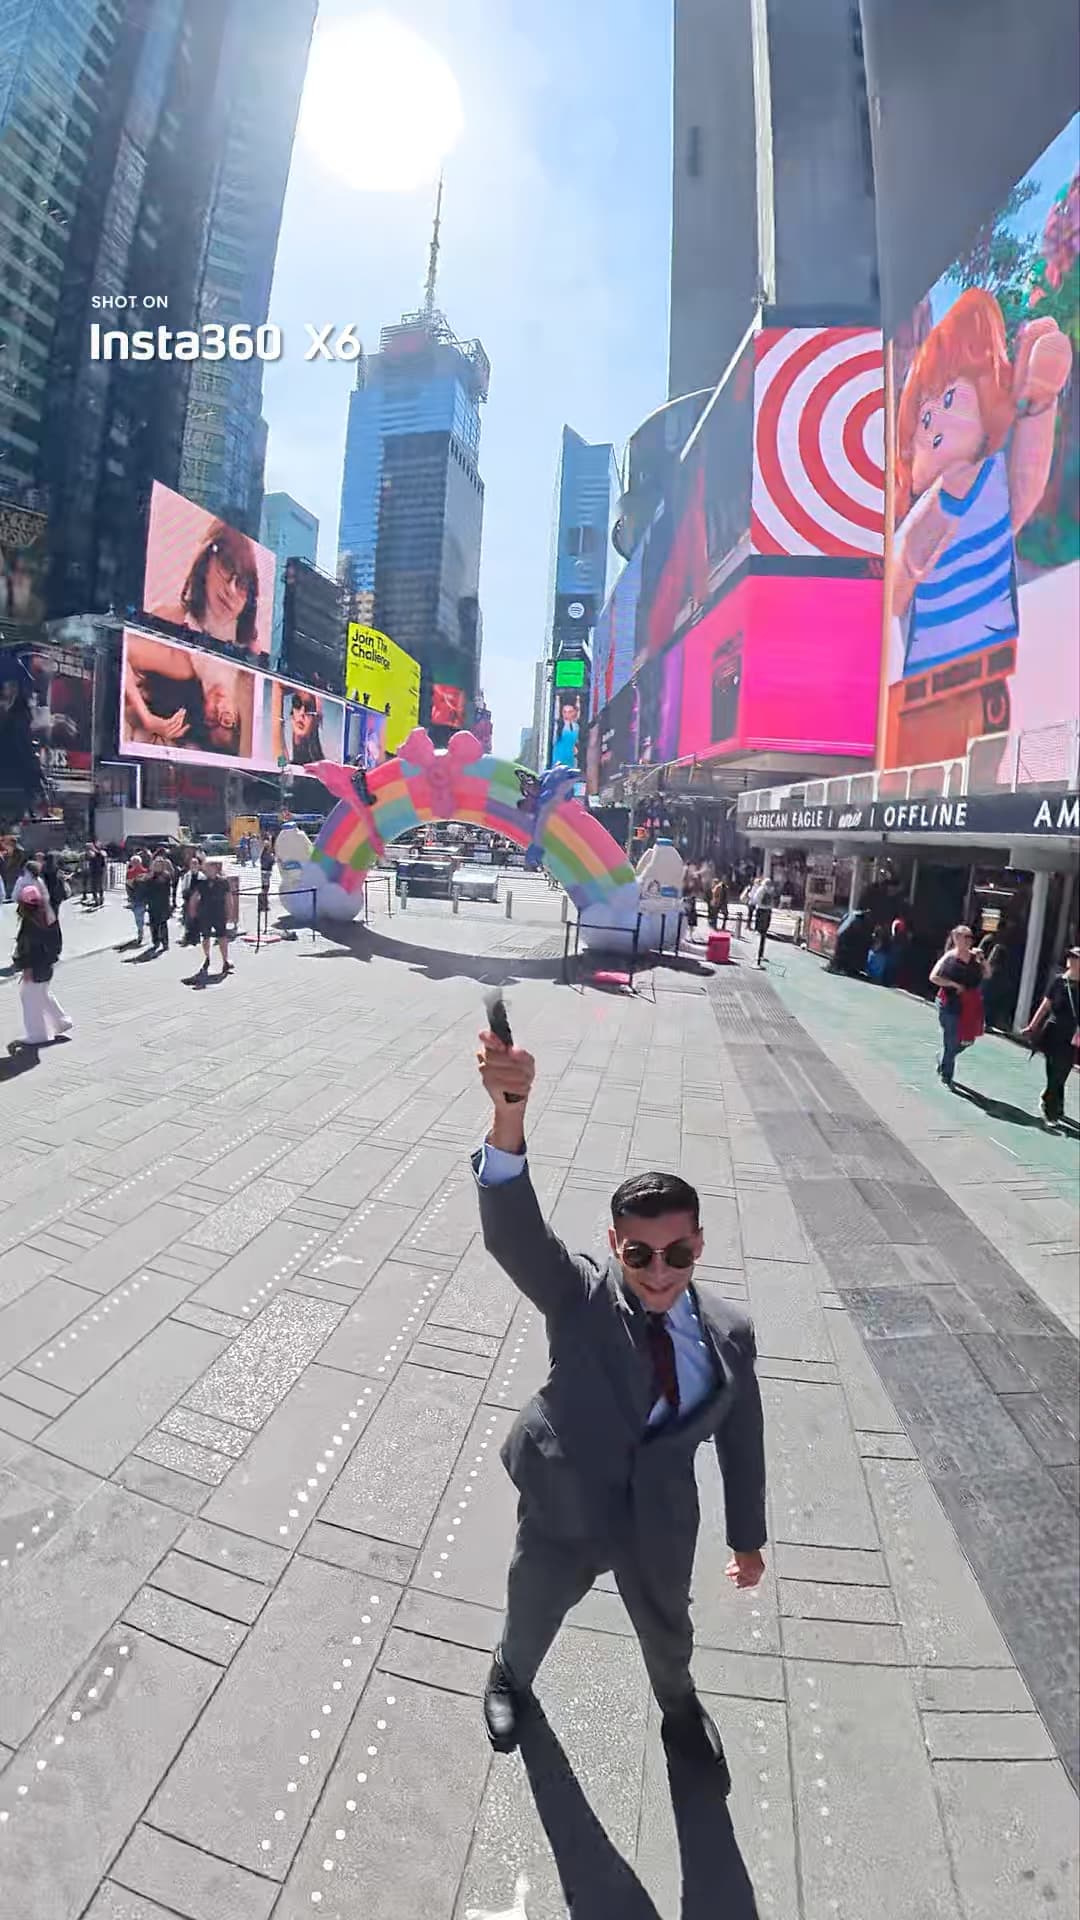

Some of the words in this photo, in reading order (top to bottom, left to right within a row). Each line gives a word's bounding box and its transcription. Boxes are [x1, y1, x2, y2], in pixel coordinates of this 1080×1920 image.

[352, 629, 375, 648] Join
[351, 643, 391, 671] Challeng
[747, 811, 788, 828] AMERICAN
[792, 810, 823, 828] EAGLE
[884, 803, 968, 827] OFFLINE
[1032, 797, 1080, 828] AM
